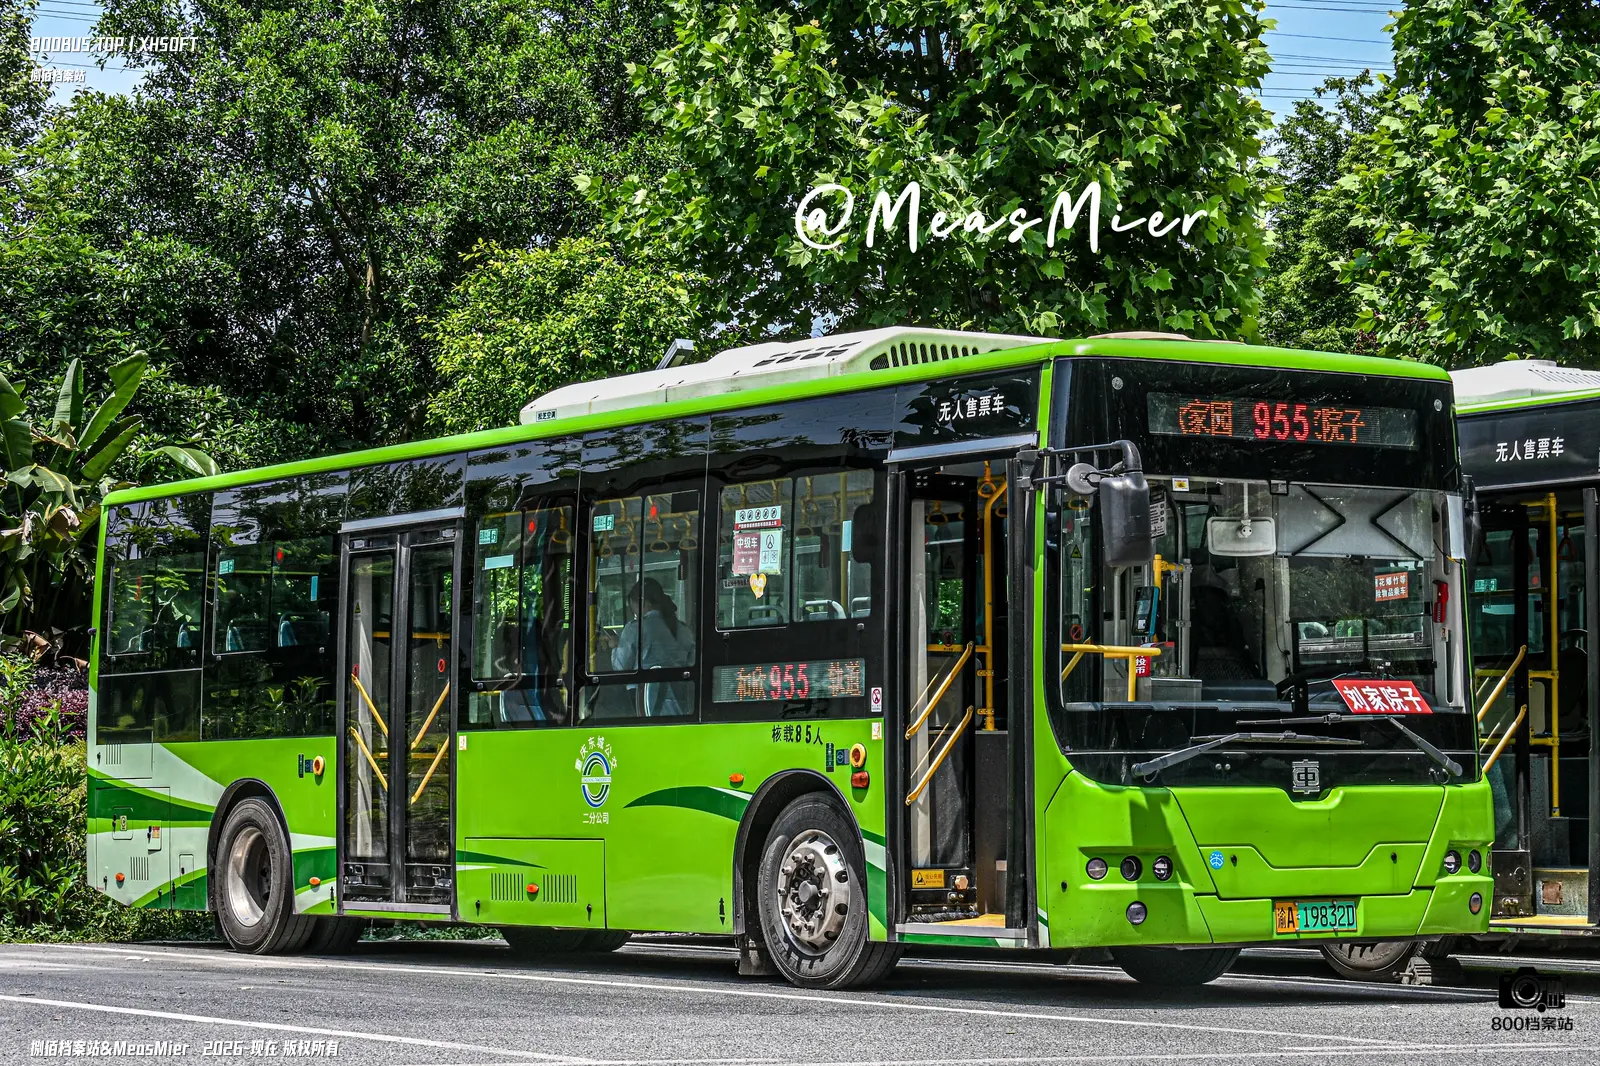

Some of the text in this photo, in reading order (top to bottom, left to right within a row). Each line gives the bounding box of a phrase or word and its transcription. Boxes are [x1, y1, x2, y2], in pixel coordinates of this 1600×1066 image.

[939, 393, 1005, 422] 无人售票车
[1254, 401, 1310, 440] 955
[1495, 436, 1564, 463] 无人售票车
[737, 536, 759, 549] 中级车
[769, 664, 810, 700] 955
[1343, 685, 1422, 712] 刘家院子
[771, 723, 824, 746] 核载85人
[582, 812, 610, 825] 二分公司
[1303, 904, 1355, 929] 19832D
